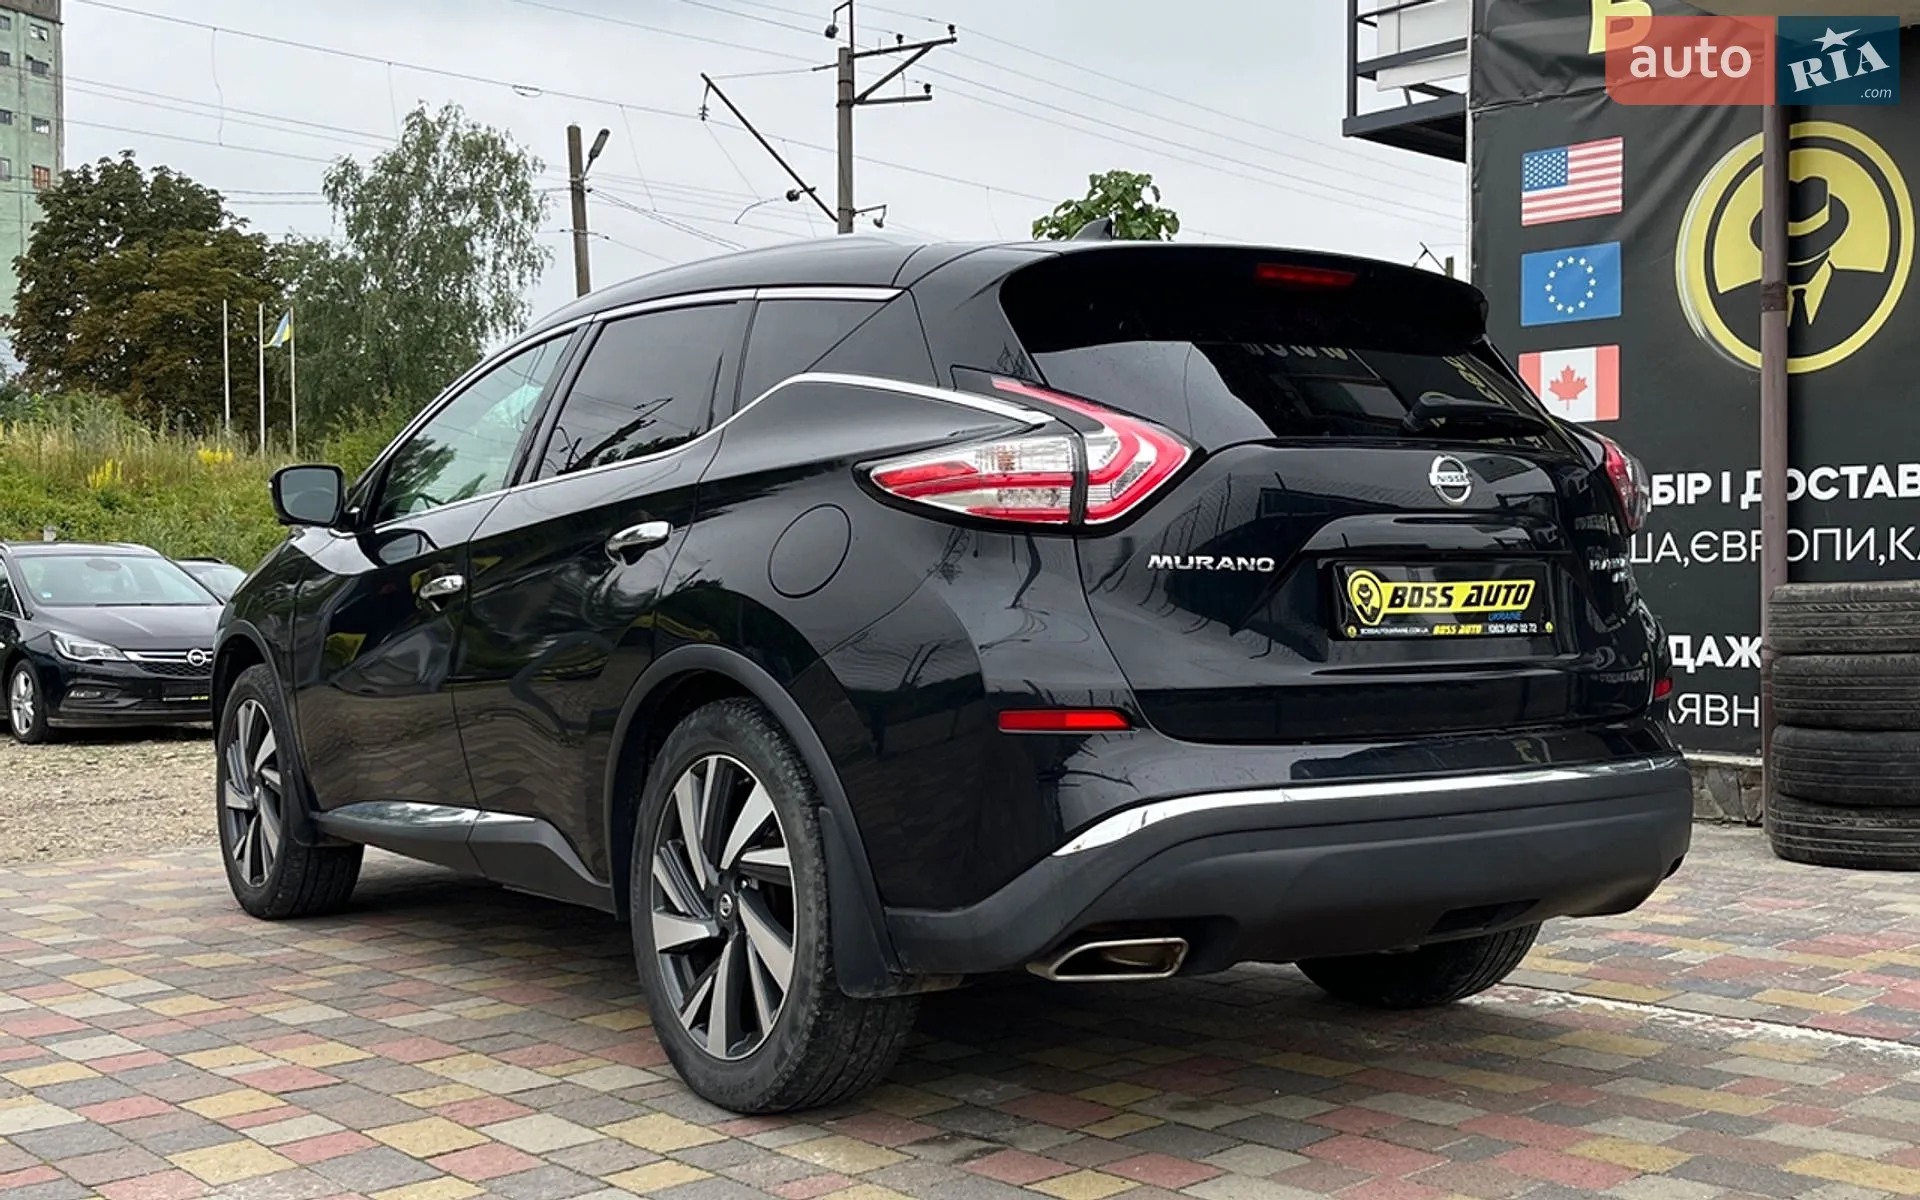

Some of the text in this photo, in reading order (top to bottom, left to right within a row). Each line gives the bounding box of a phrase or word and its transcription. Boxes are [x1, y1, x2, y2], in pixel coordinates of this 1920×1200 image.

[1647, 472, 1712, 513] БІР
[1147, 554, 1276, 573] MURANO
[1388, 584, 1528, 608] BOSS AUTO
